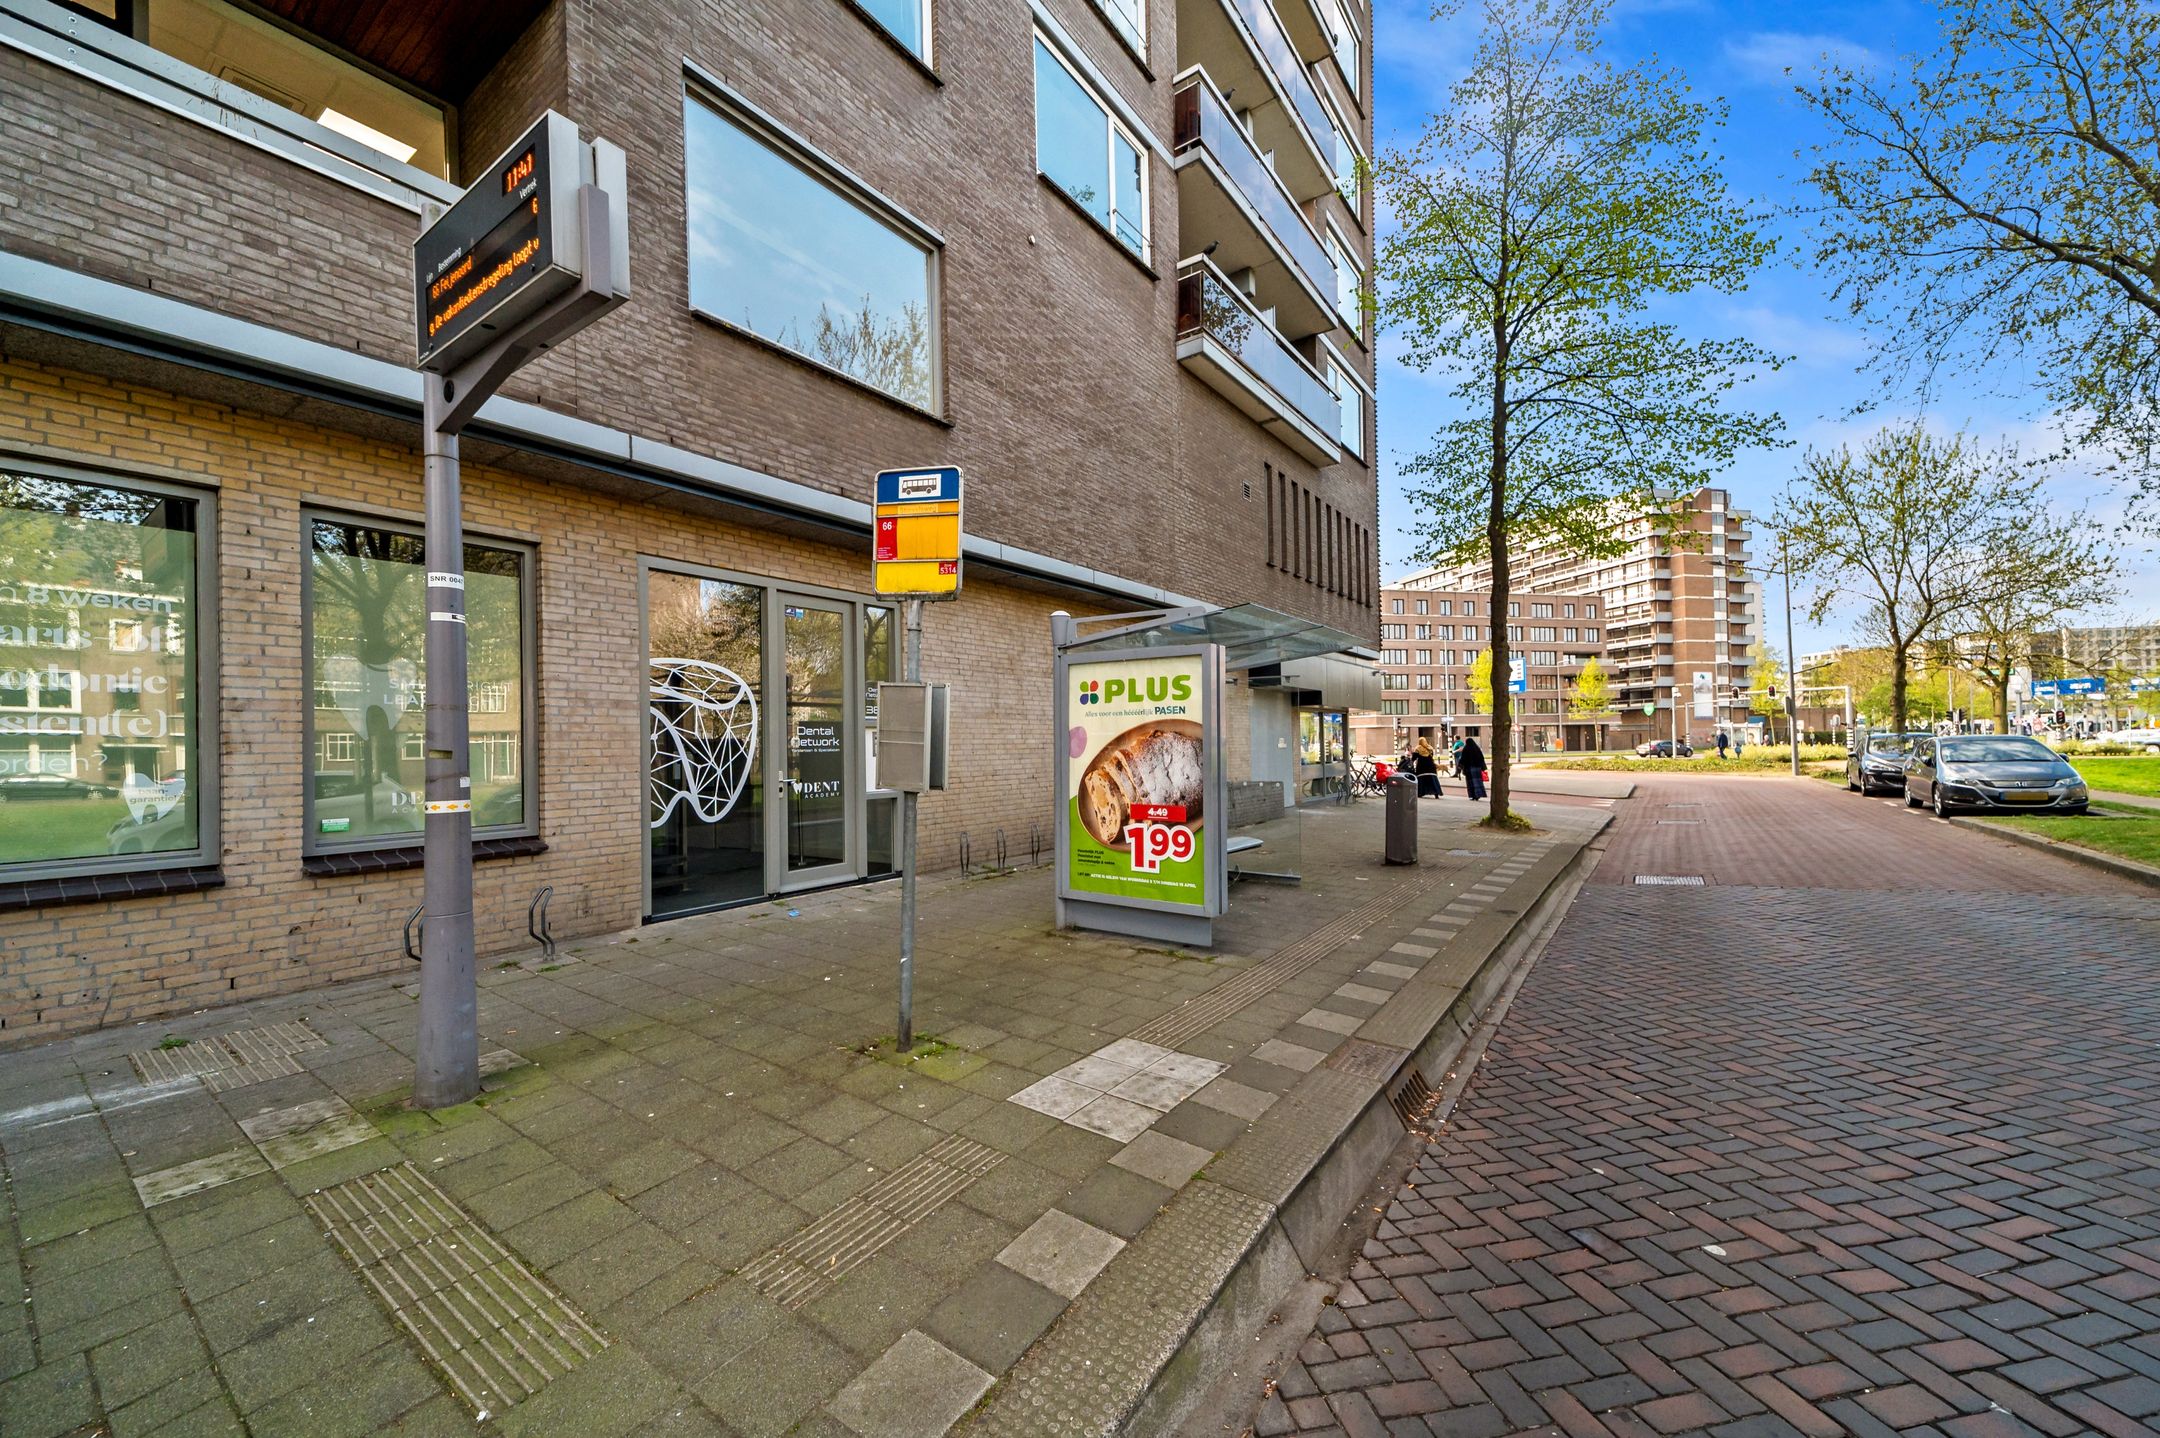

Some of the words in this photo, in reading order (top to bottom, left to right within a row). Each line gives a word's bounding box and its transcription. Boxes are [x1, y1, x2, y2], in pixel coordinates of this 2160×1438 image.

[507, 153, 533, 193] 11:41
[519, 177, 538, 199] Vertrek
[513, 240, 533, 267] loopt
[882, 521, 893, 531] 66
[940, 566, 957, 575] 5314
[27, 586, 50, 605] 8
[58, 591, 173, 613] weken
[1104, 674, 1192, 704] PLUS
[1155, 705, 1186, 716] PASEN
[796, 726, 834, 736] Dental
[804, 780, 840, 793] DENT
[804, 791, 840, 799] ACADEMY
[1147, 807, 1169, 817] 4.49
[1126, 825, 1193, 871] 1.99
